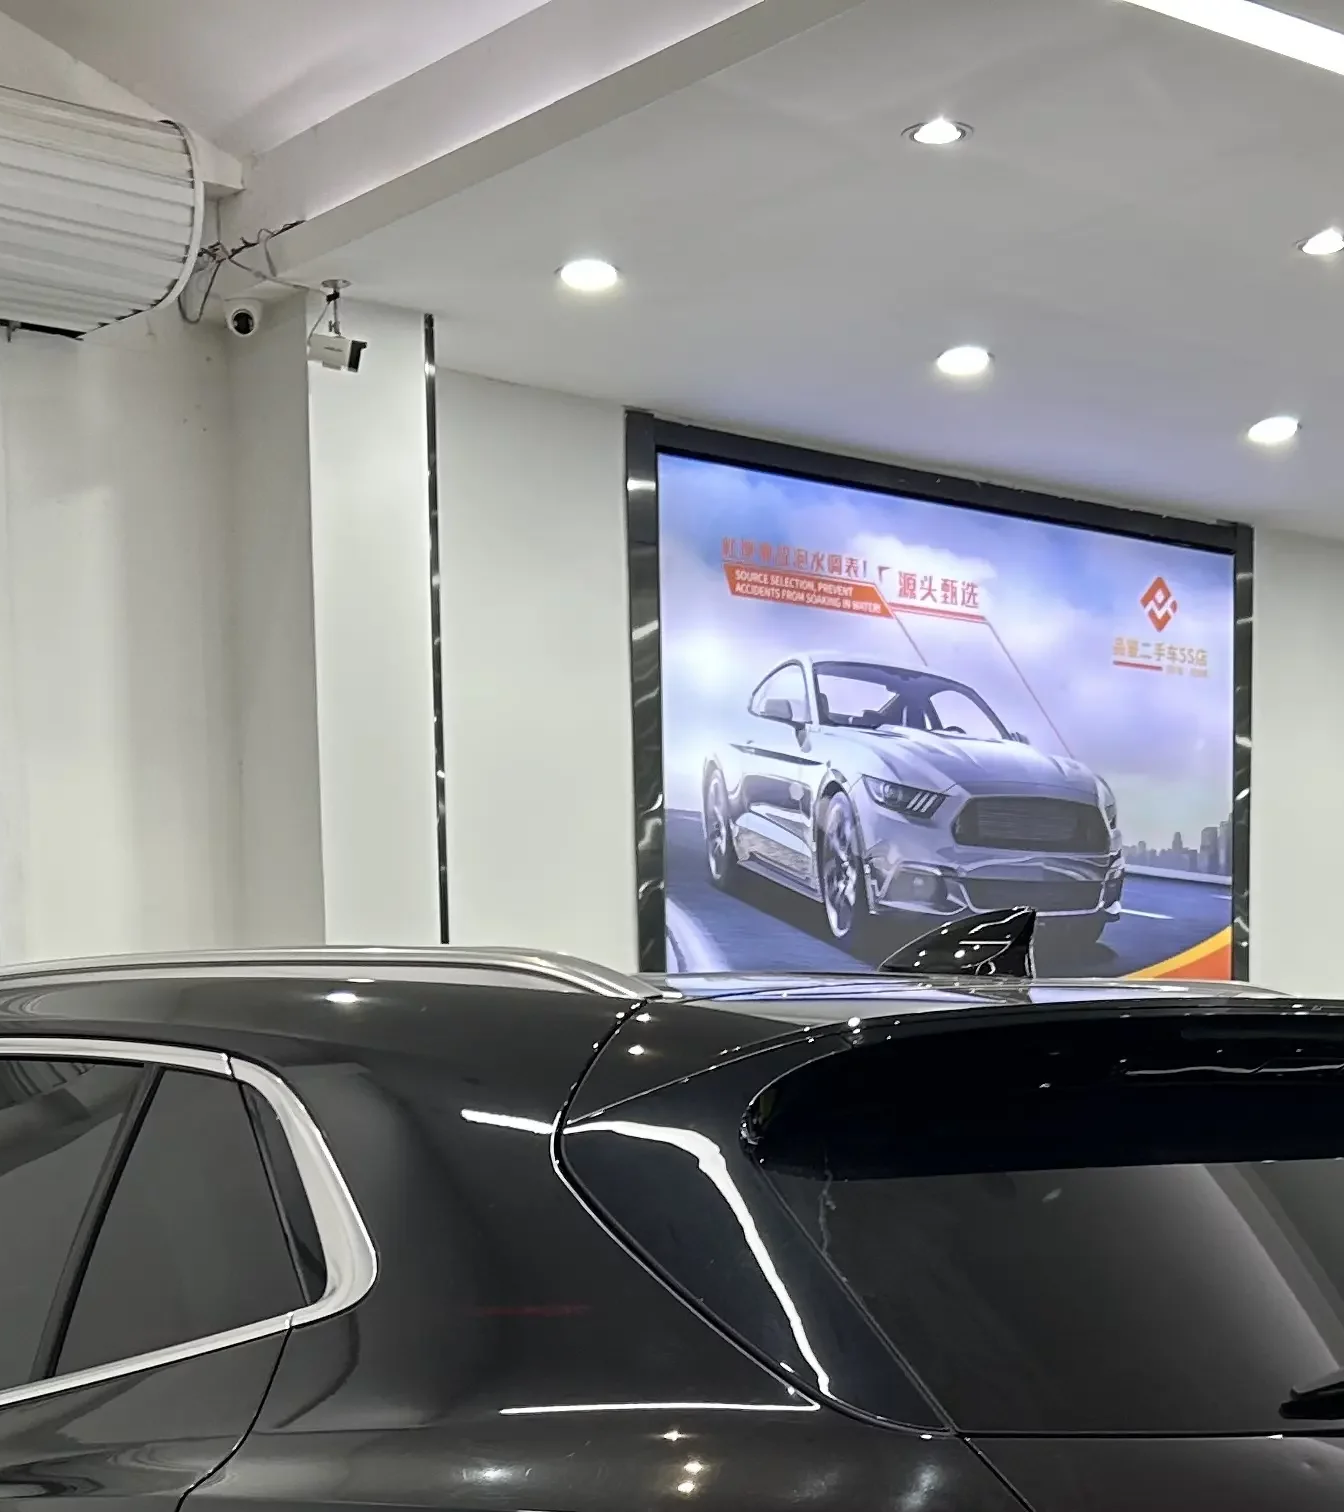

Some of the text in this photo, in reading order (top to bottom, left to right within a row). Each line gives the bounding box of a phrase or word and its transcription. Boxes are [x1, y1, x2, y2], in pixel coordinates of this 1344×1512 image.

[734, 570, 854, 597] SOURCE SELECTION, PREVENT
[734, 583, 781, 599] ACCIDENTS
[782, 589, 805, 602] FROM
[806, 593, 841, 608] SOAKING
[841, 599, 851, 609] IN
[898, 570, 979, 608] 源头甄选
